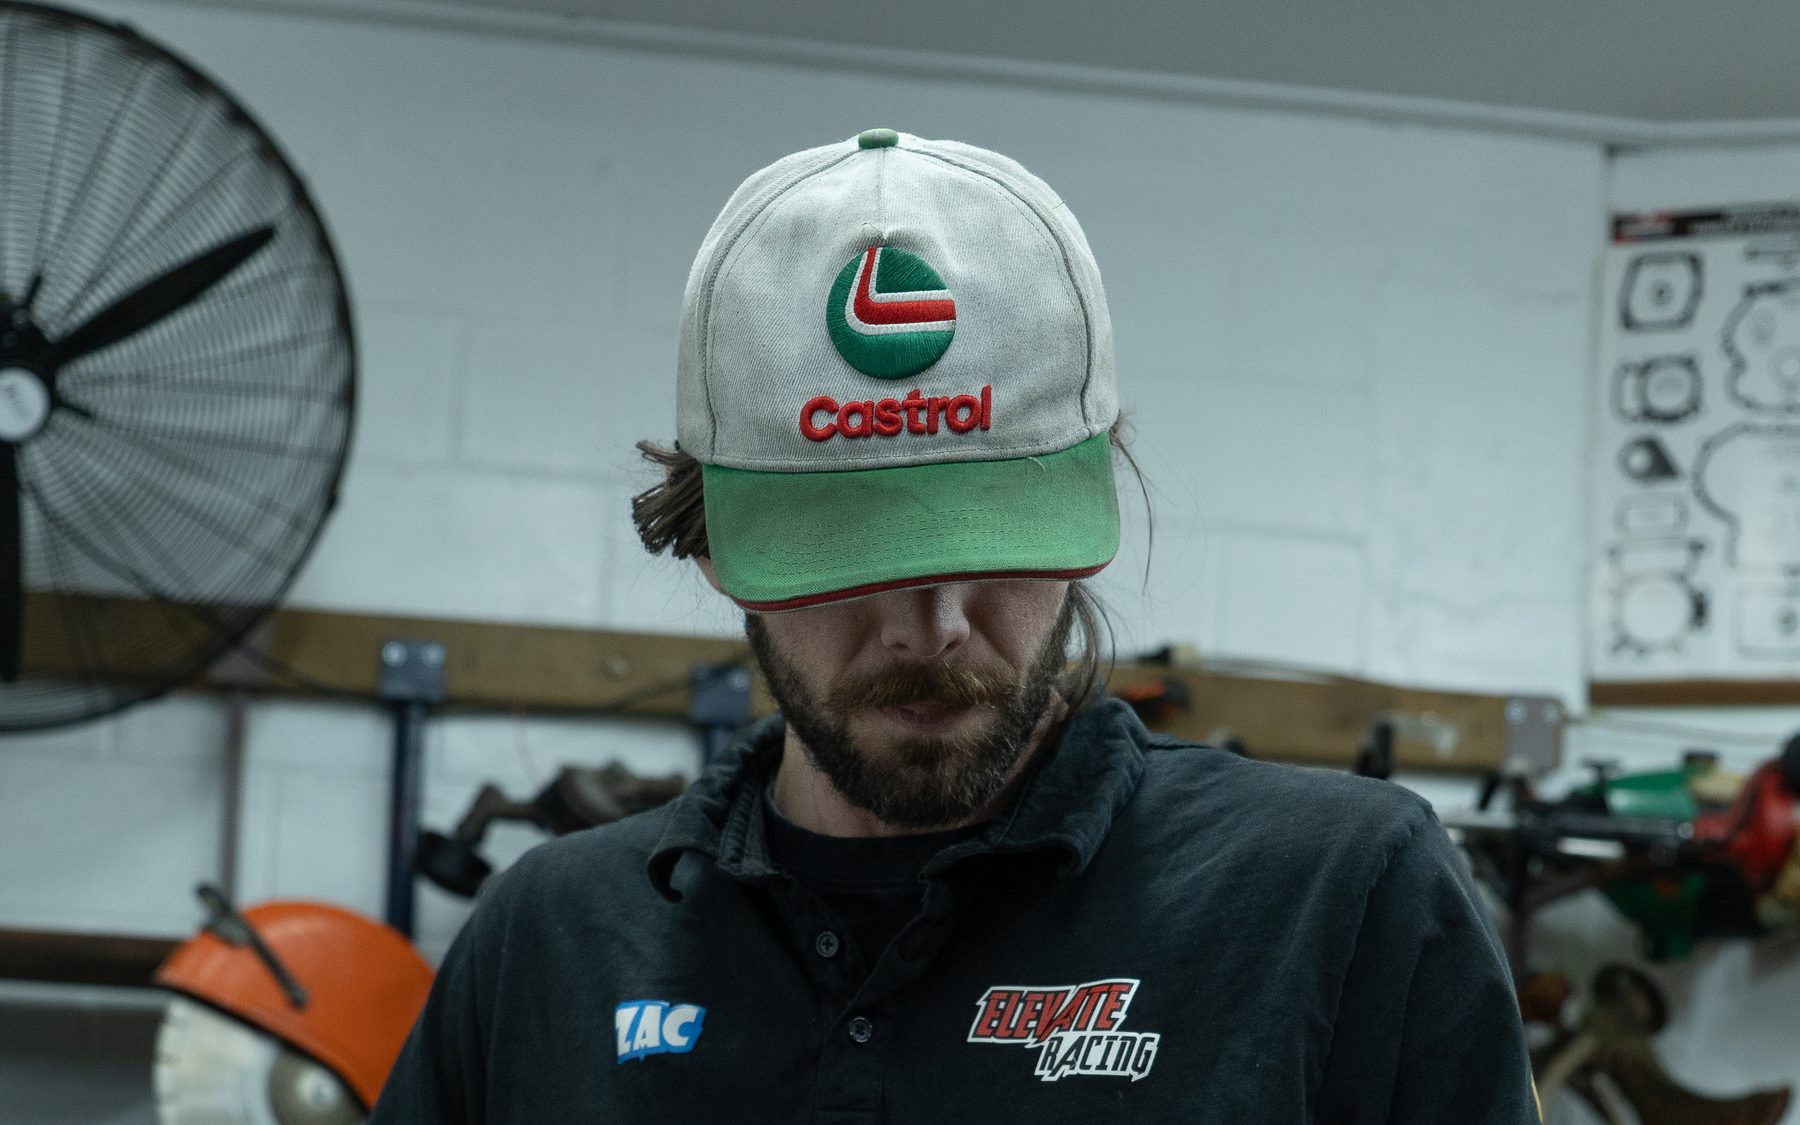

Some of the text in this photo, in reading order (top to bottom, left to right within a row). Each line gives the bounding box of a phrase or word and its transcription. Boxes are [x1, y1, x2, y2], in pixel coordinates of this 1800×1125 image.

[800, 384, 992, 442] Castrol
[615, 1004, 700, 1057] ZAC
[972, 982, 1134, 1043] ELEVATE
[1037, 1034, 1158, 1078] RACING
